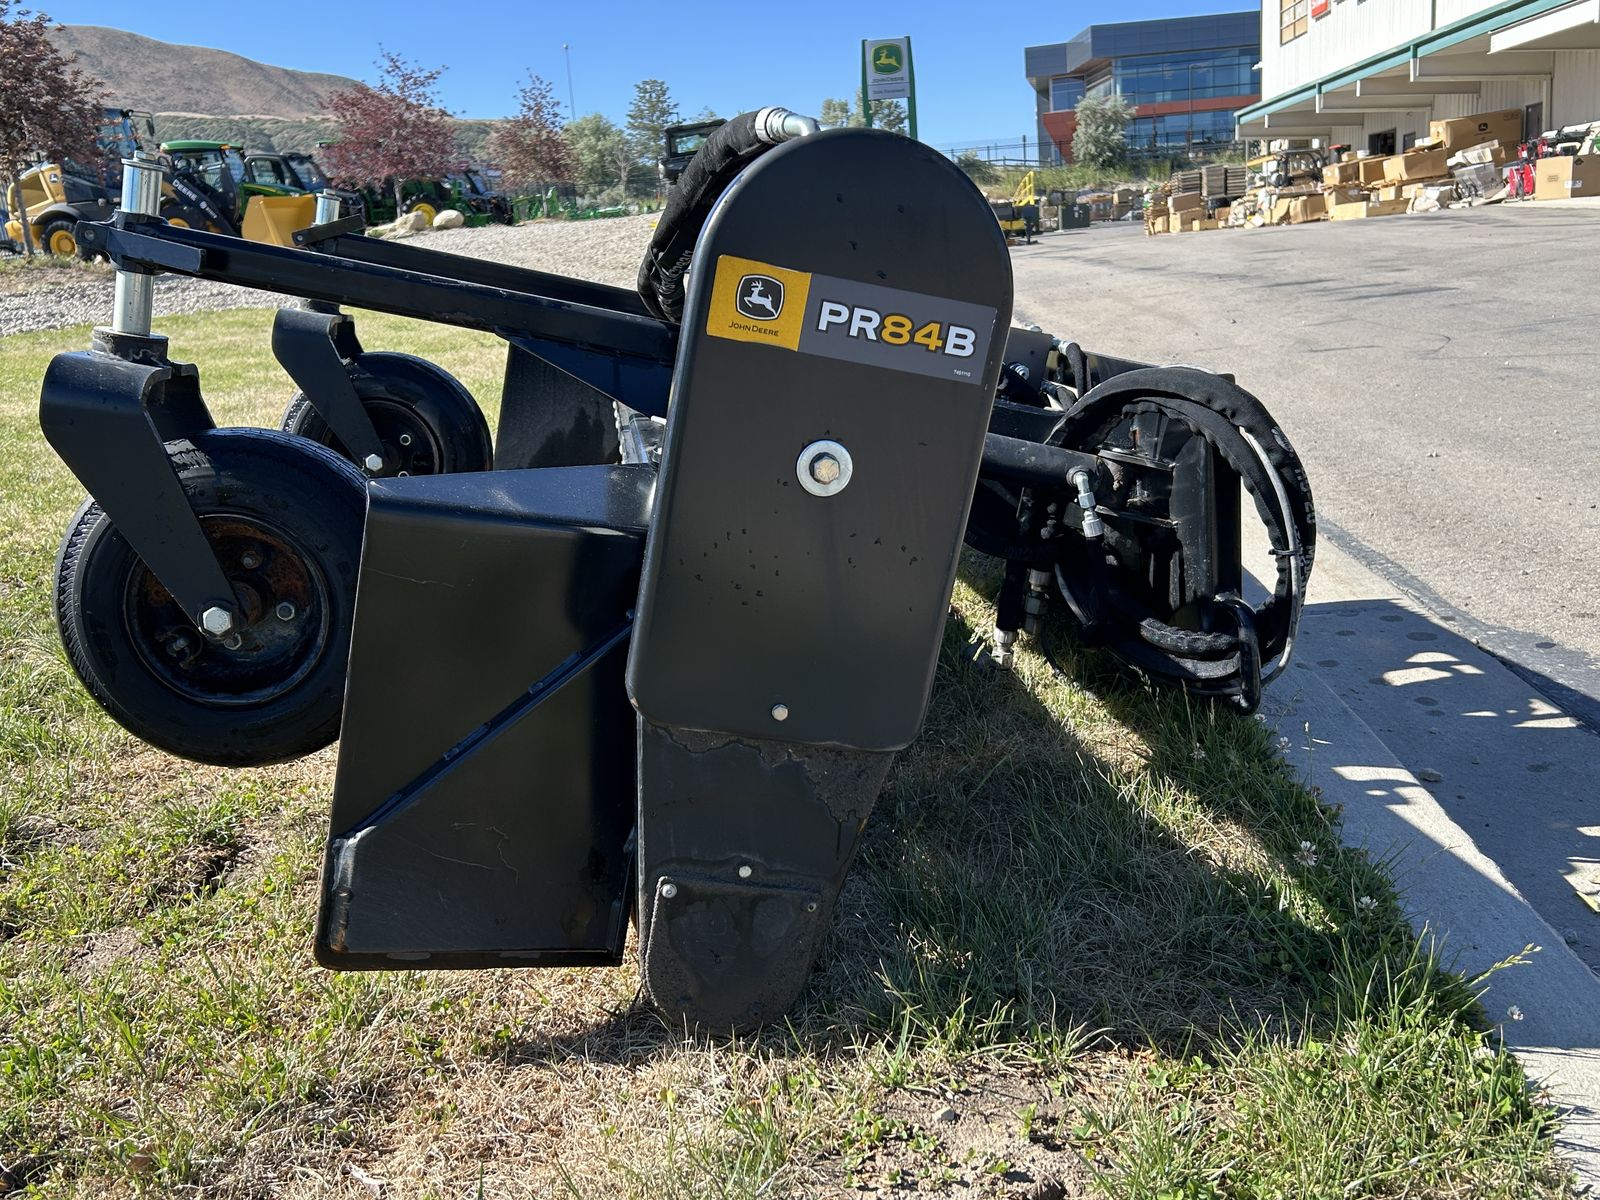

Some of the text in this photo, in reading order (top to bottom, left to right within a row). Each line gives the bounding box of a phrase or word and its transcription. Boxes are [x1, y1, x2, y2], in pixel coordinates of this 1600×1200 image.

[172, 179, 198, 201] DEERE
[728, 321, 779, 337] JOHN DEERE
[817, 301, 976, 357] PR84B
